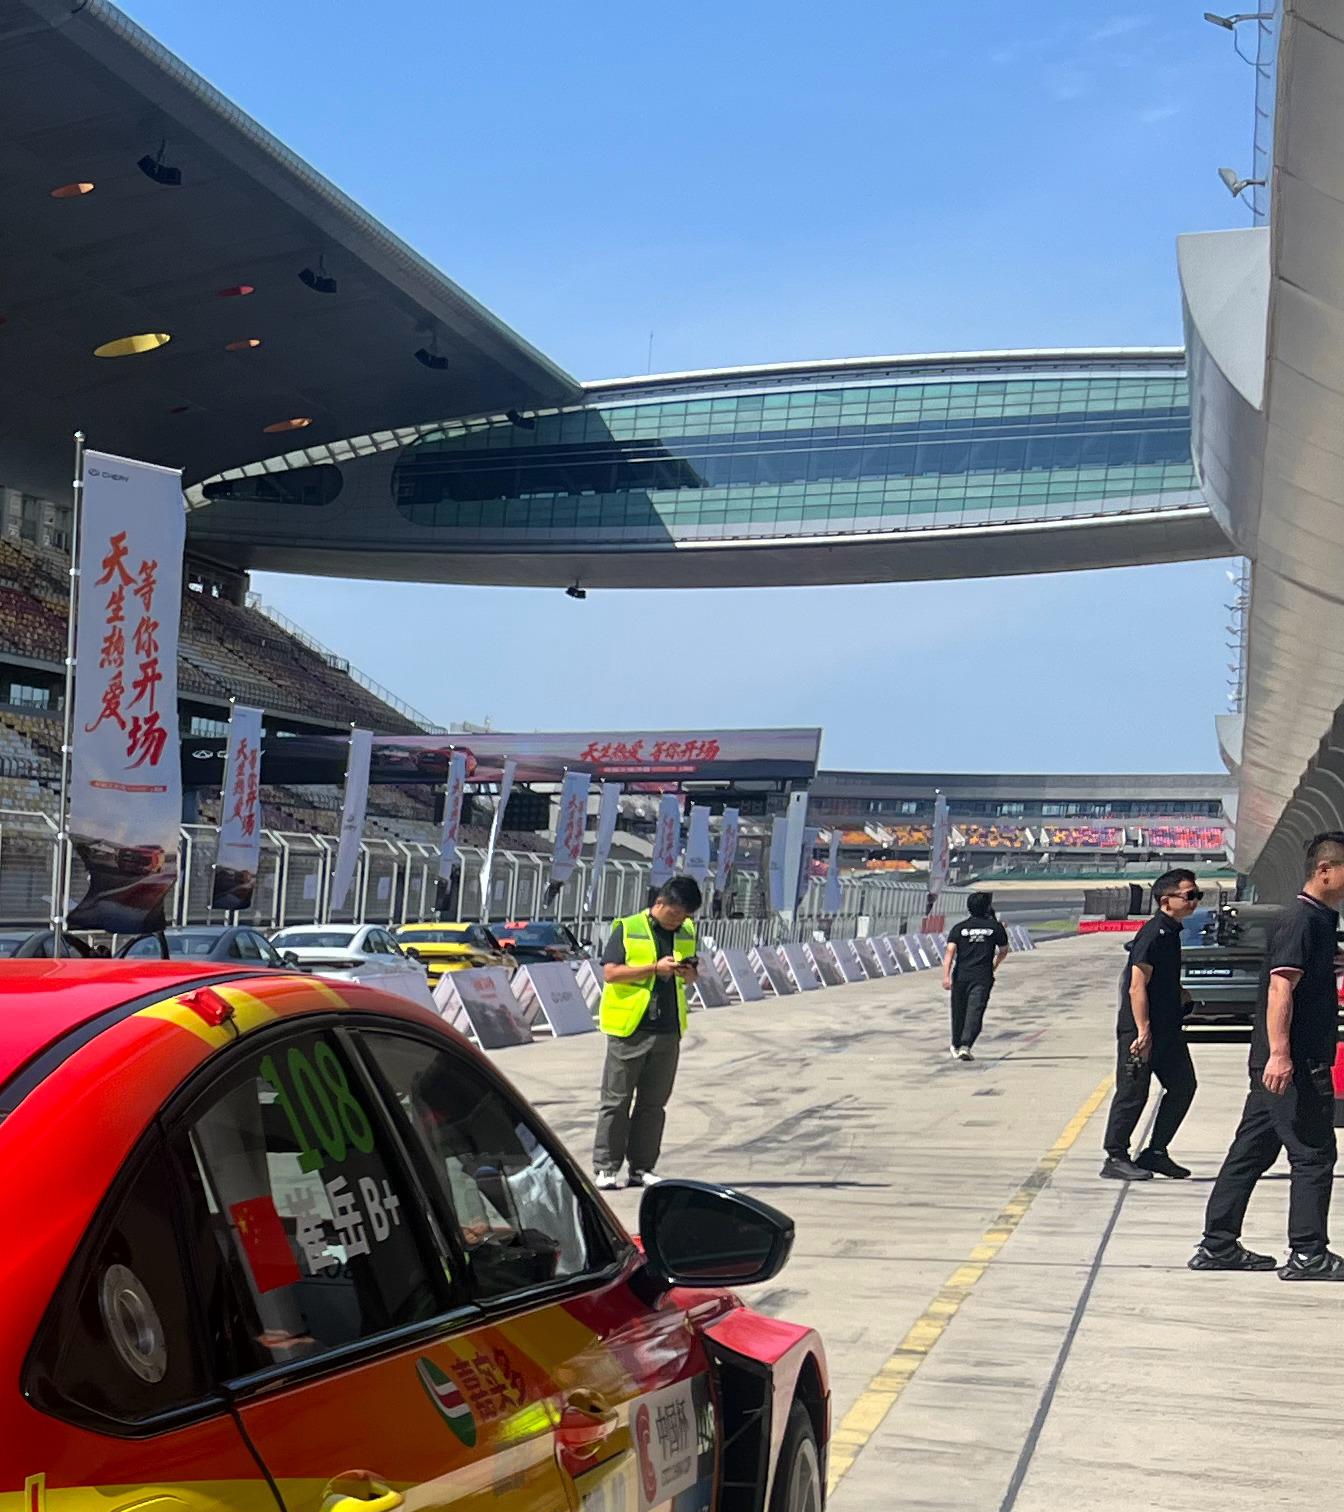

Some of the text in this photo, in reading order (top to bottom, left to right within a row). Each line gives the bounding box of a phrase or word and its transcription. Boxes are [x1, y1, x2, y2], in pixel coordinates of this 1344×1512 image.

[85, 531, 138, 733] 天生热爱
[124, 560, 167, 770] 等你开场
[259, 1041, 374, 1173] 108
